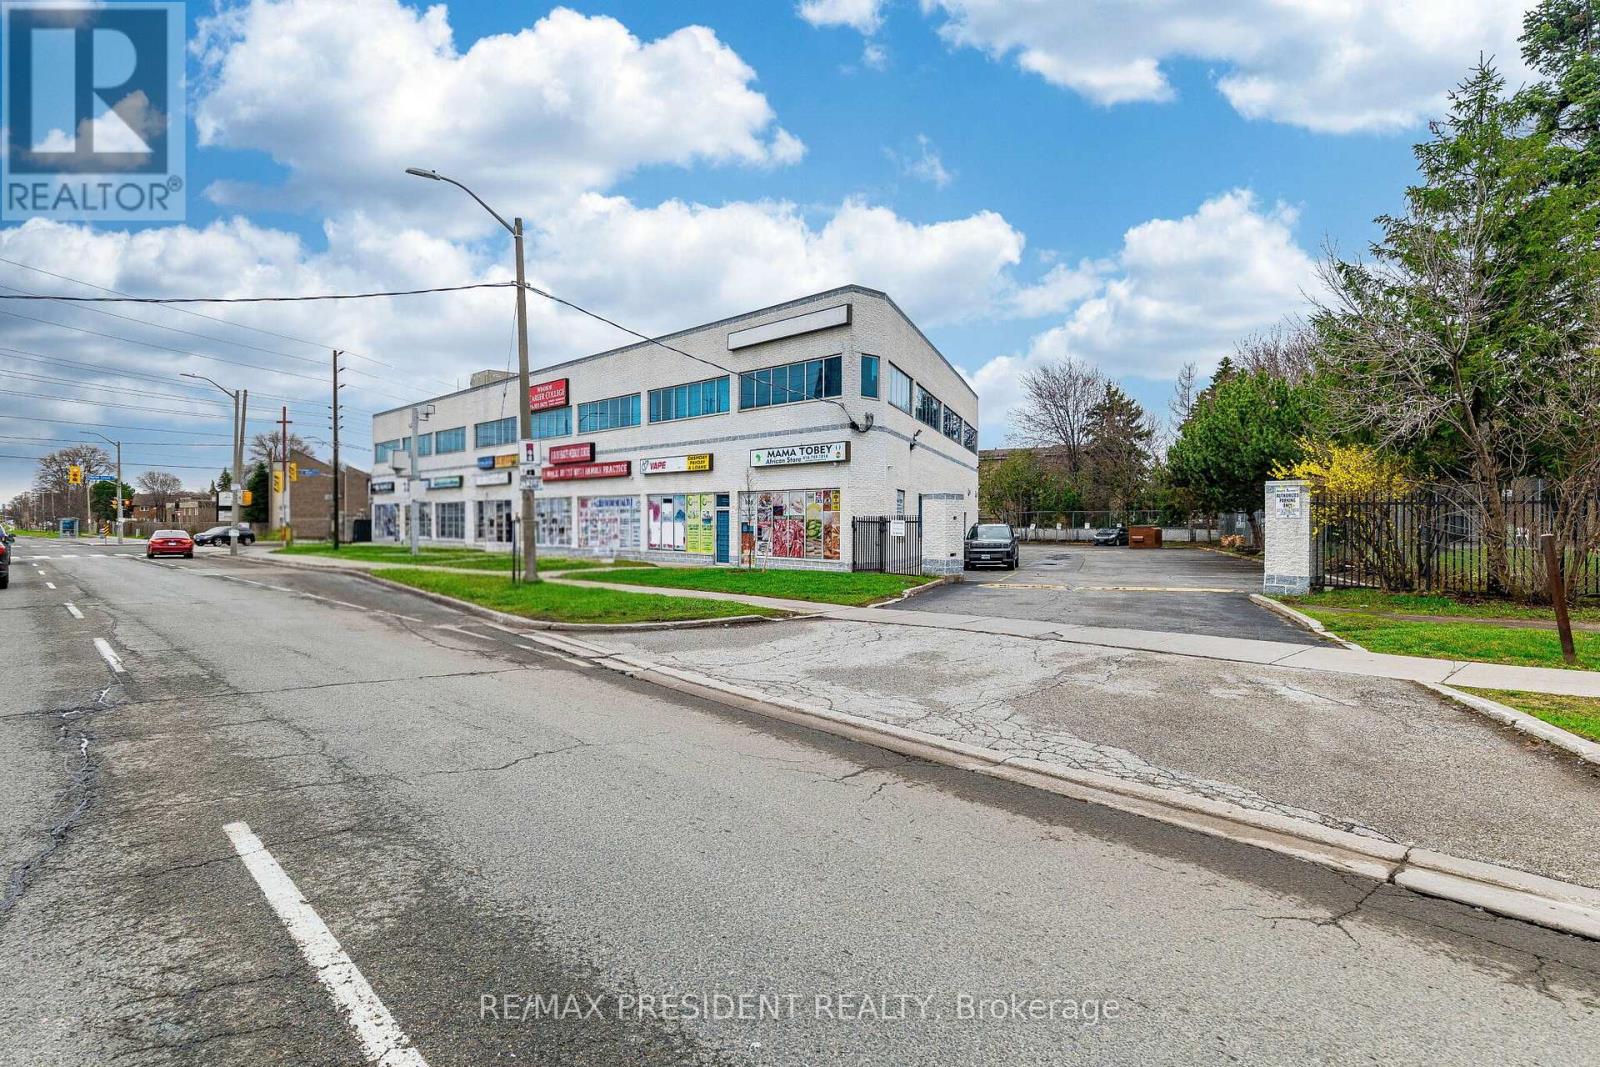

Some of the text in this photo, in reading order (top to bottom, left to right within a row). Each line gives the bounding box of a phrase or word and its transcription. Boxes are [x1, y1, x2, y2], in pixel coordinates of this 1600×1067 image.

[767, 444, 833, 458] MAMA TOBEY
[650, 461, 667, 470] VAPE
[765, 457, 786, 465] African
[602, 464, 628, 474] PRACTICE
